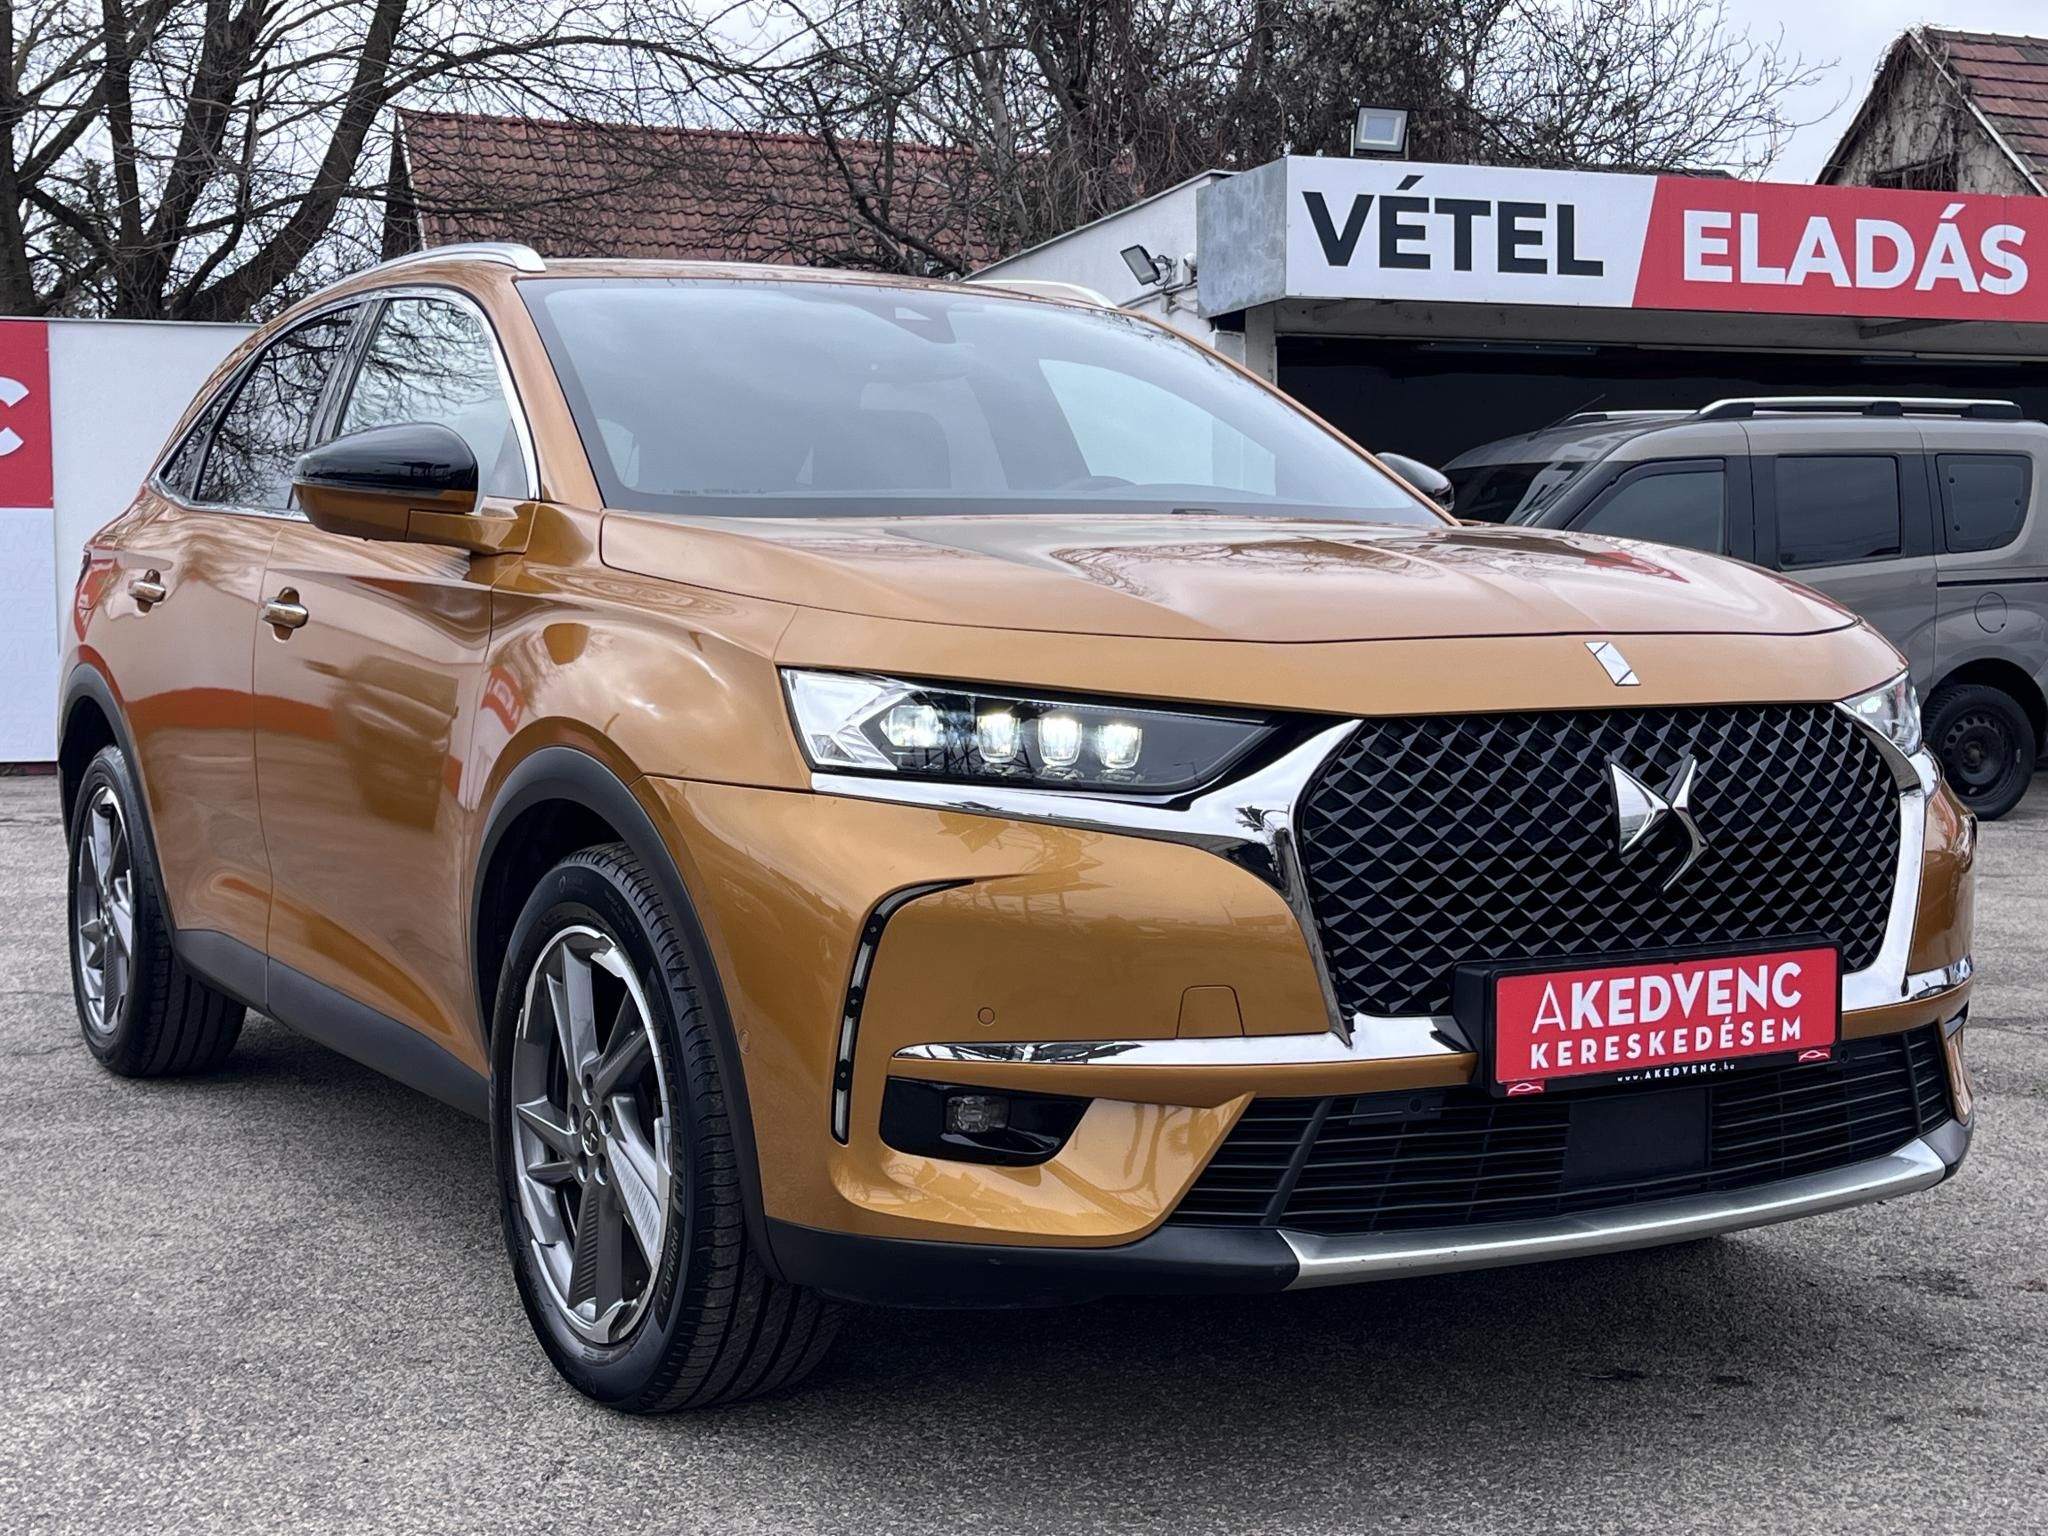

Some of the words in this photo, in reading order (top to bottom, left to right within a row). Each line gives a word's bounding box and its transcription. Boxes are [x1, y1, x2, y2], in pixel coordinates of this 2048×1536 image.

[1302, 175, 1604, 277] VÉTEL
[1683, 202, 2029, 296] ELADÁS
[1531, 961, 1802, 1034] AKEDVENC
[1530, 1015, 1801, 1070] KERESKEDÉSEM
